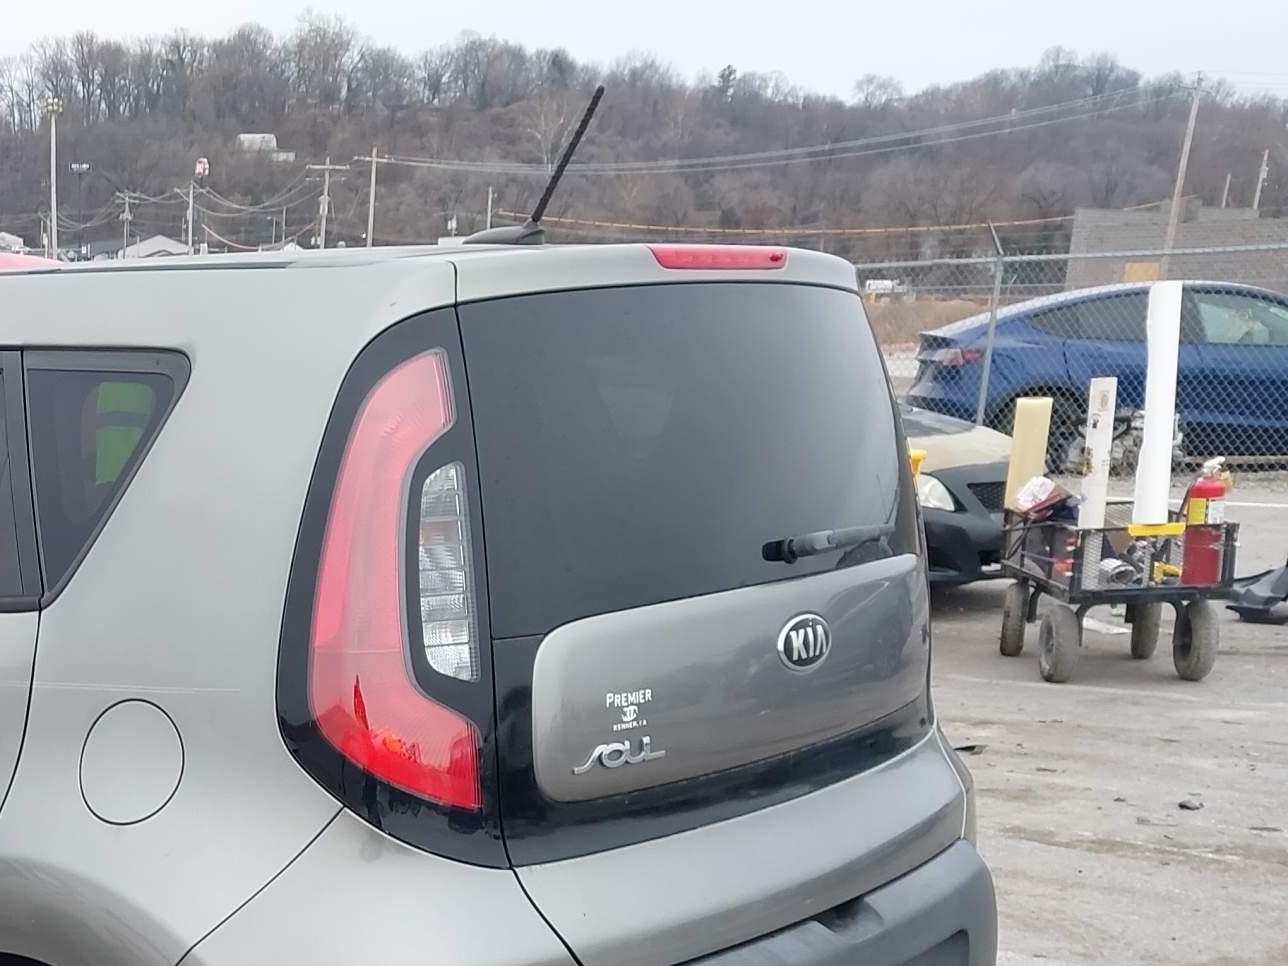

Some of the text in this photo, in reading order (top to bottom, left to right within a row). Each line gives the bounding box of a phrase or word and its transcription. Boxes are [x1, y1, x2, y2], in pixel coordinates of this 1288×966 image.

[789, 620, 828, 662] KIA
[606, 688, 653, 709] PREMIER
[572, 736, 666, 776] SOUL
